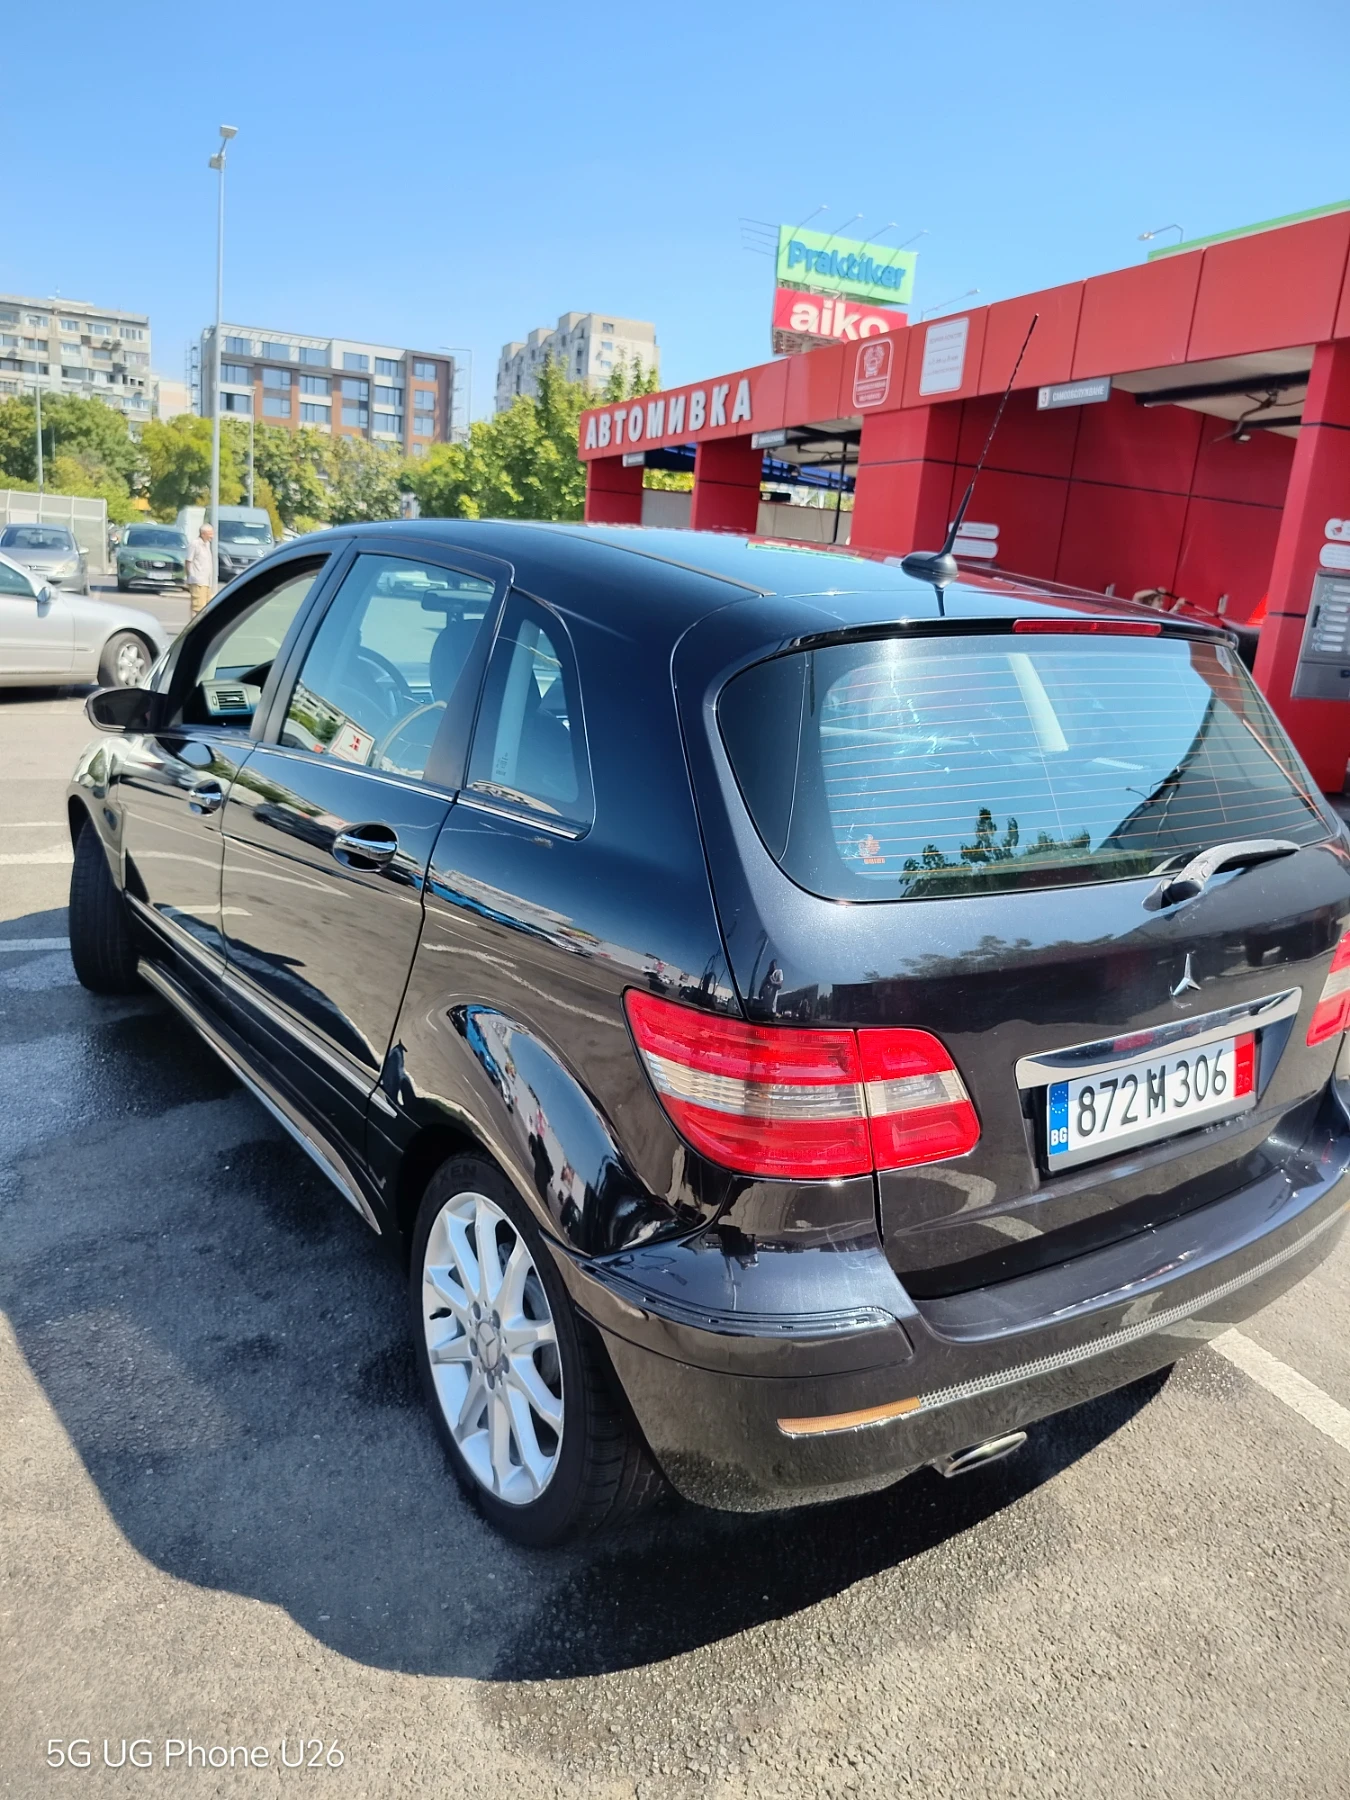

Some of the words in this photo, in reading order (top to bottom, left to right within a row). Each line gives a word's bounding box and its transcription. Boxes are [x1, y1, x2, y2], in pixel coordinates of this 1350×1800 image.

[788, 239, 906, 290] Praktiker
[790, 299, 890, 341] aiko
[584, 378, 752, 451] АВТОМИВКА
[1051, 1128, 1068, 1147] BG
[1076, 1073, 1139, 1138] 872
[1146, 1064, 1167, 1119] M
[1173, 1048, 1228, 1109] 306
